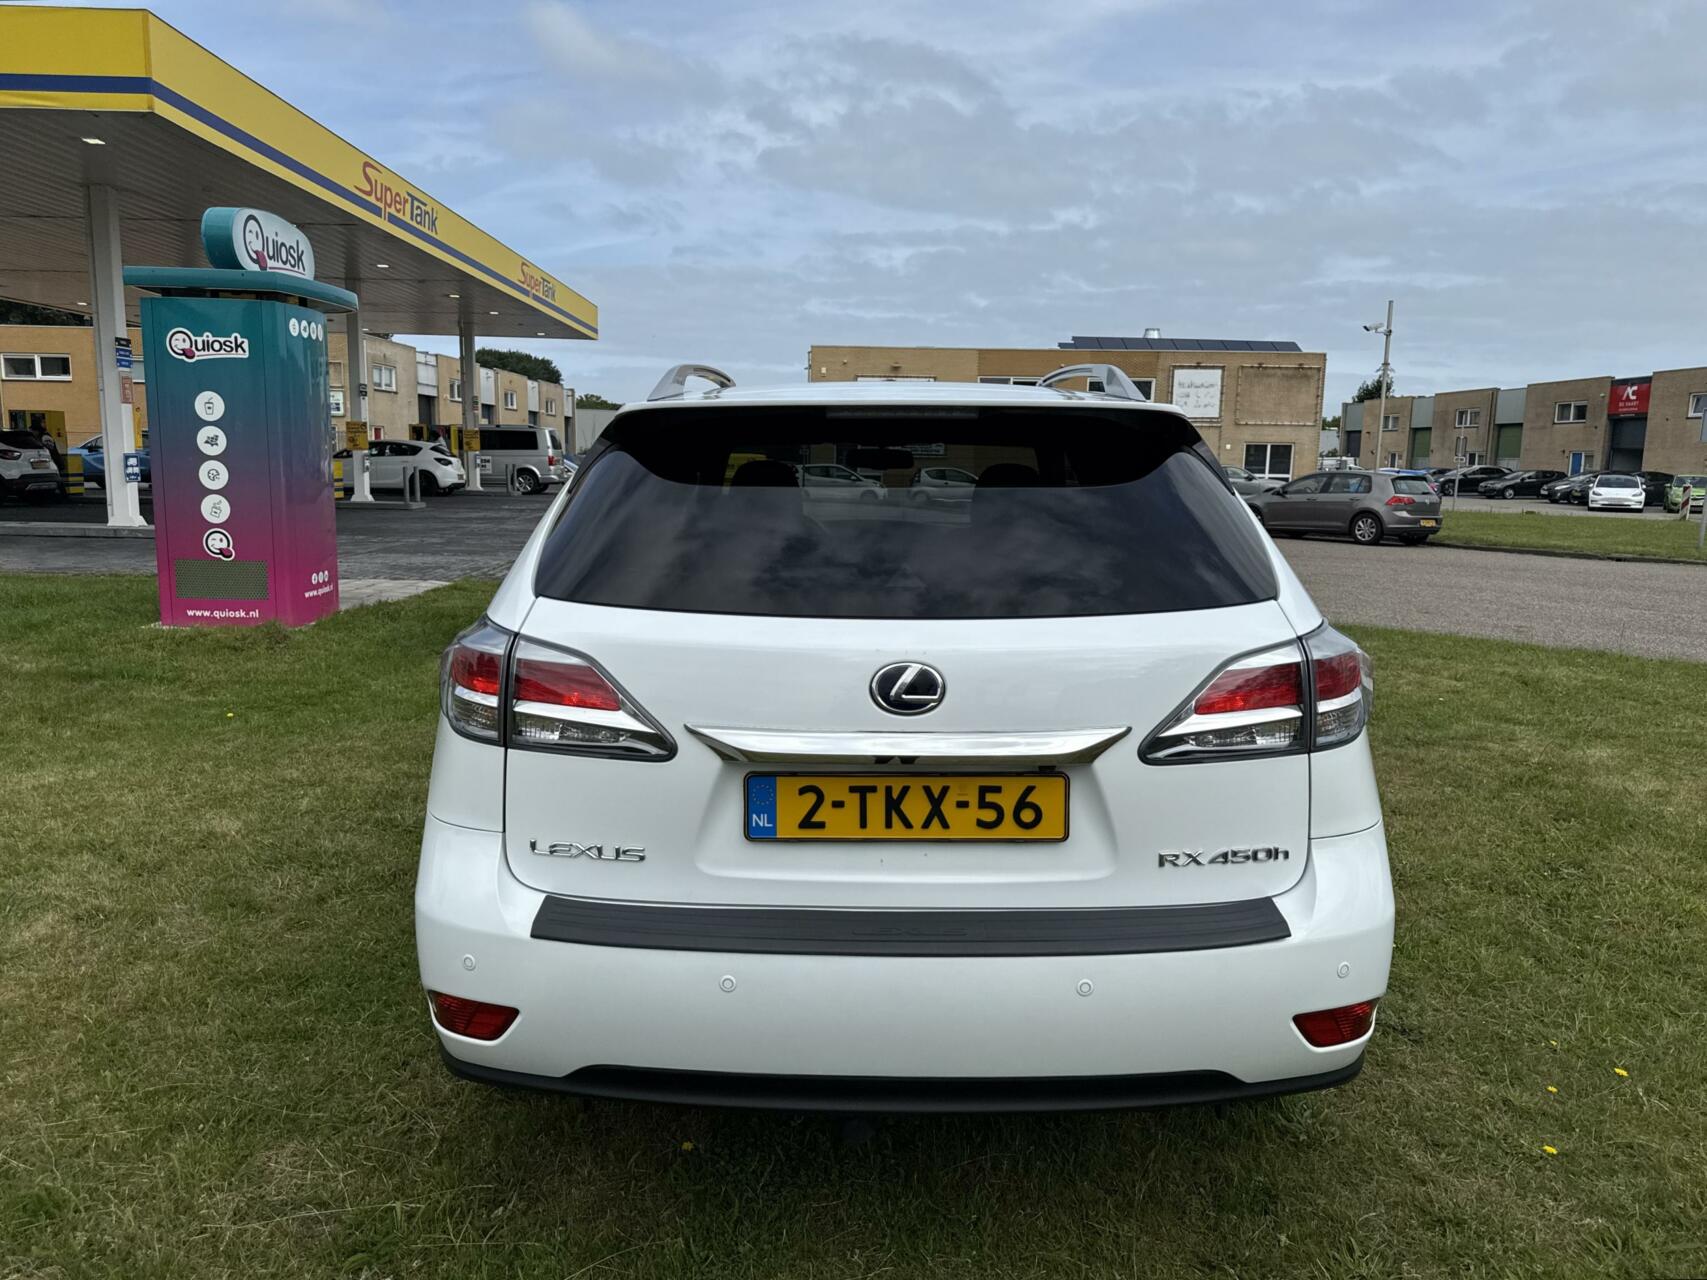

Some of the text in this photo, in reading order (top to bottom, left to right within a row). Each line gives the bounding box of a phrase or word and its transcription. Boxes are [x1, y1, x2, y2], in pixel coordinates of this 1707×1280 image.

[354, 161, 438, 235] SuperTank
[243, 214, 306, 272] Quiosk
[169, 330, 246, 359] Quiosk
[187, 608, 259, 620] www.quiosk.nl
[751, 813, 774, 827] NL
[797, 784, 1043, 830] 2-TKX-56
[529, 839, 646, 862] LEXUS
